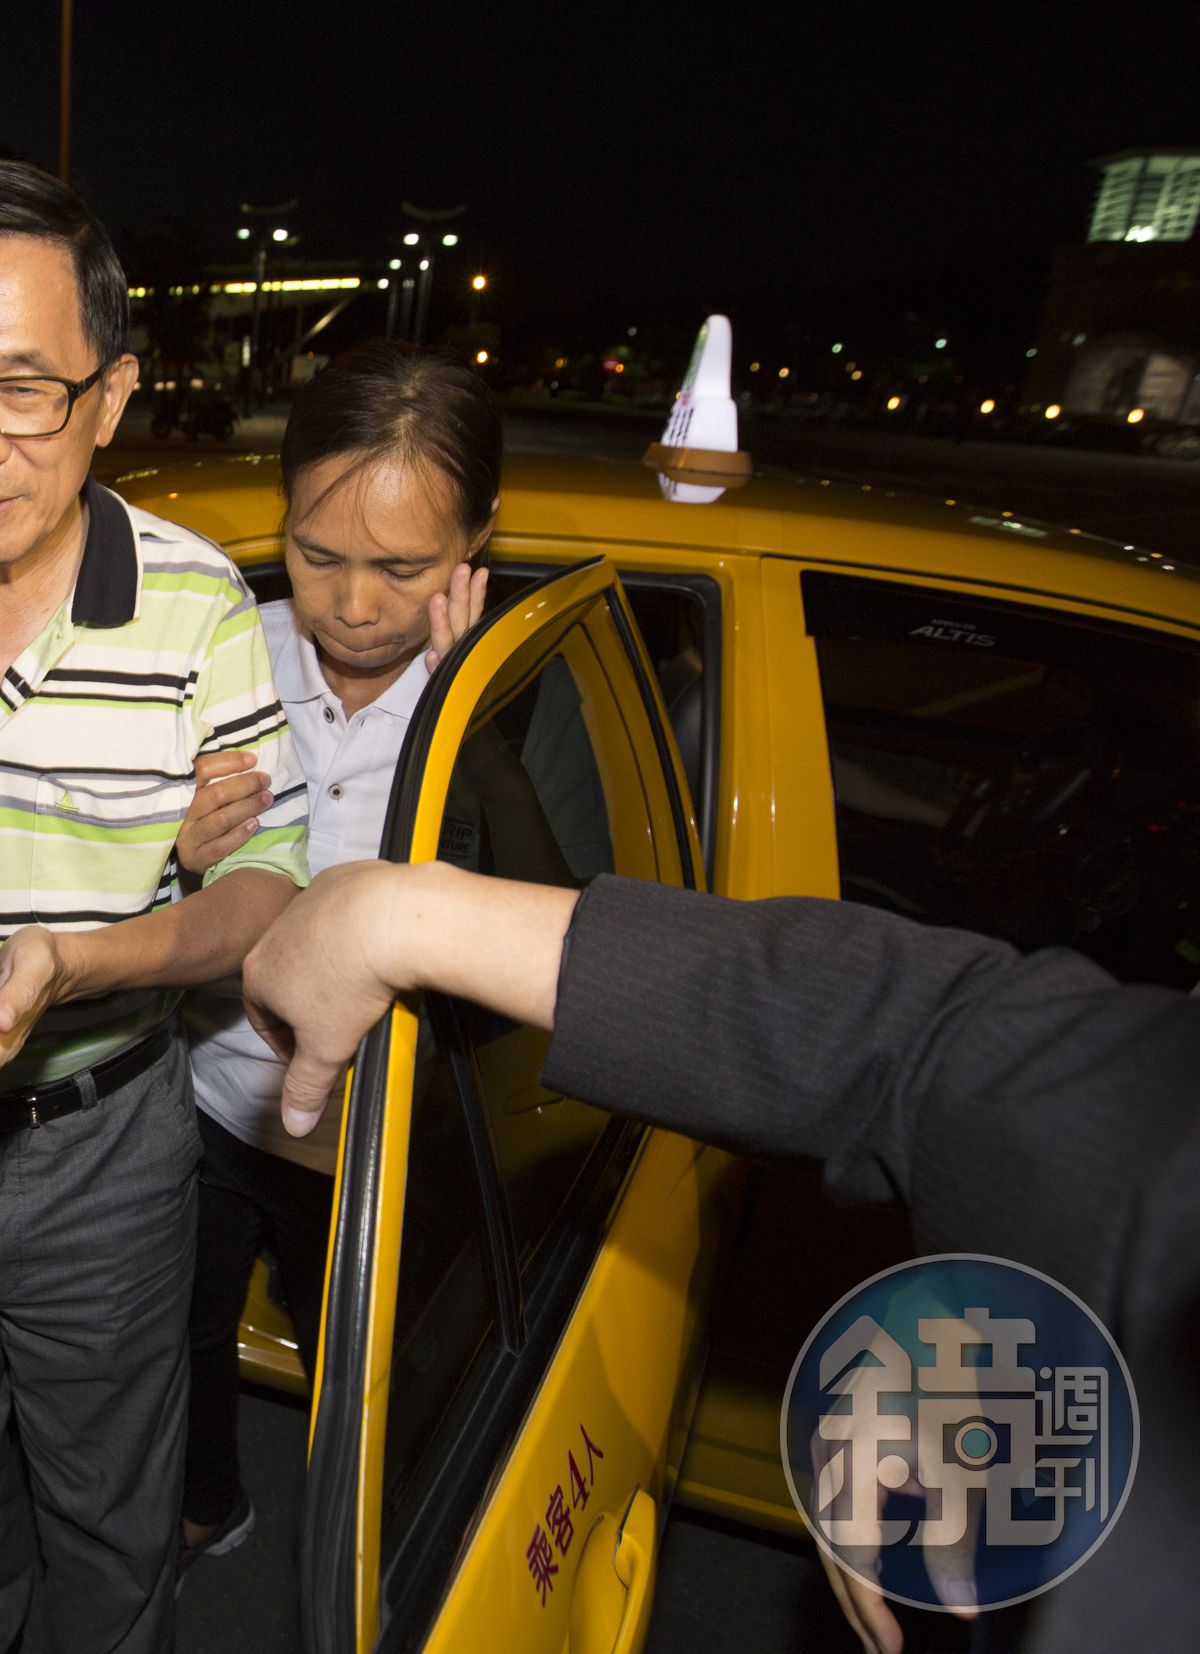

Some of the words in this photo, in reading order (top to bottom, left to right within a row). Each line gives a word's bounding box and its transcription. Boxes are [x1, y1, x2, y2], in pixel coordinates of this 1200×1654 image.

[910, 625, 996, 648] ALTIS
[526, 1424, 604, 1608] 乘客4人
